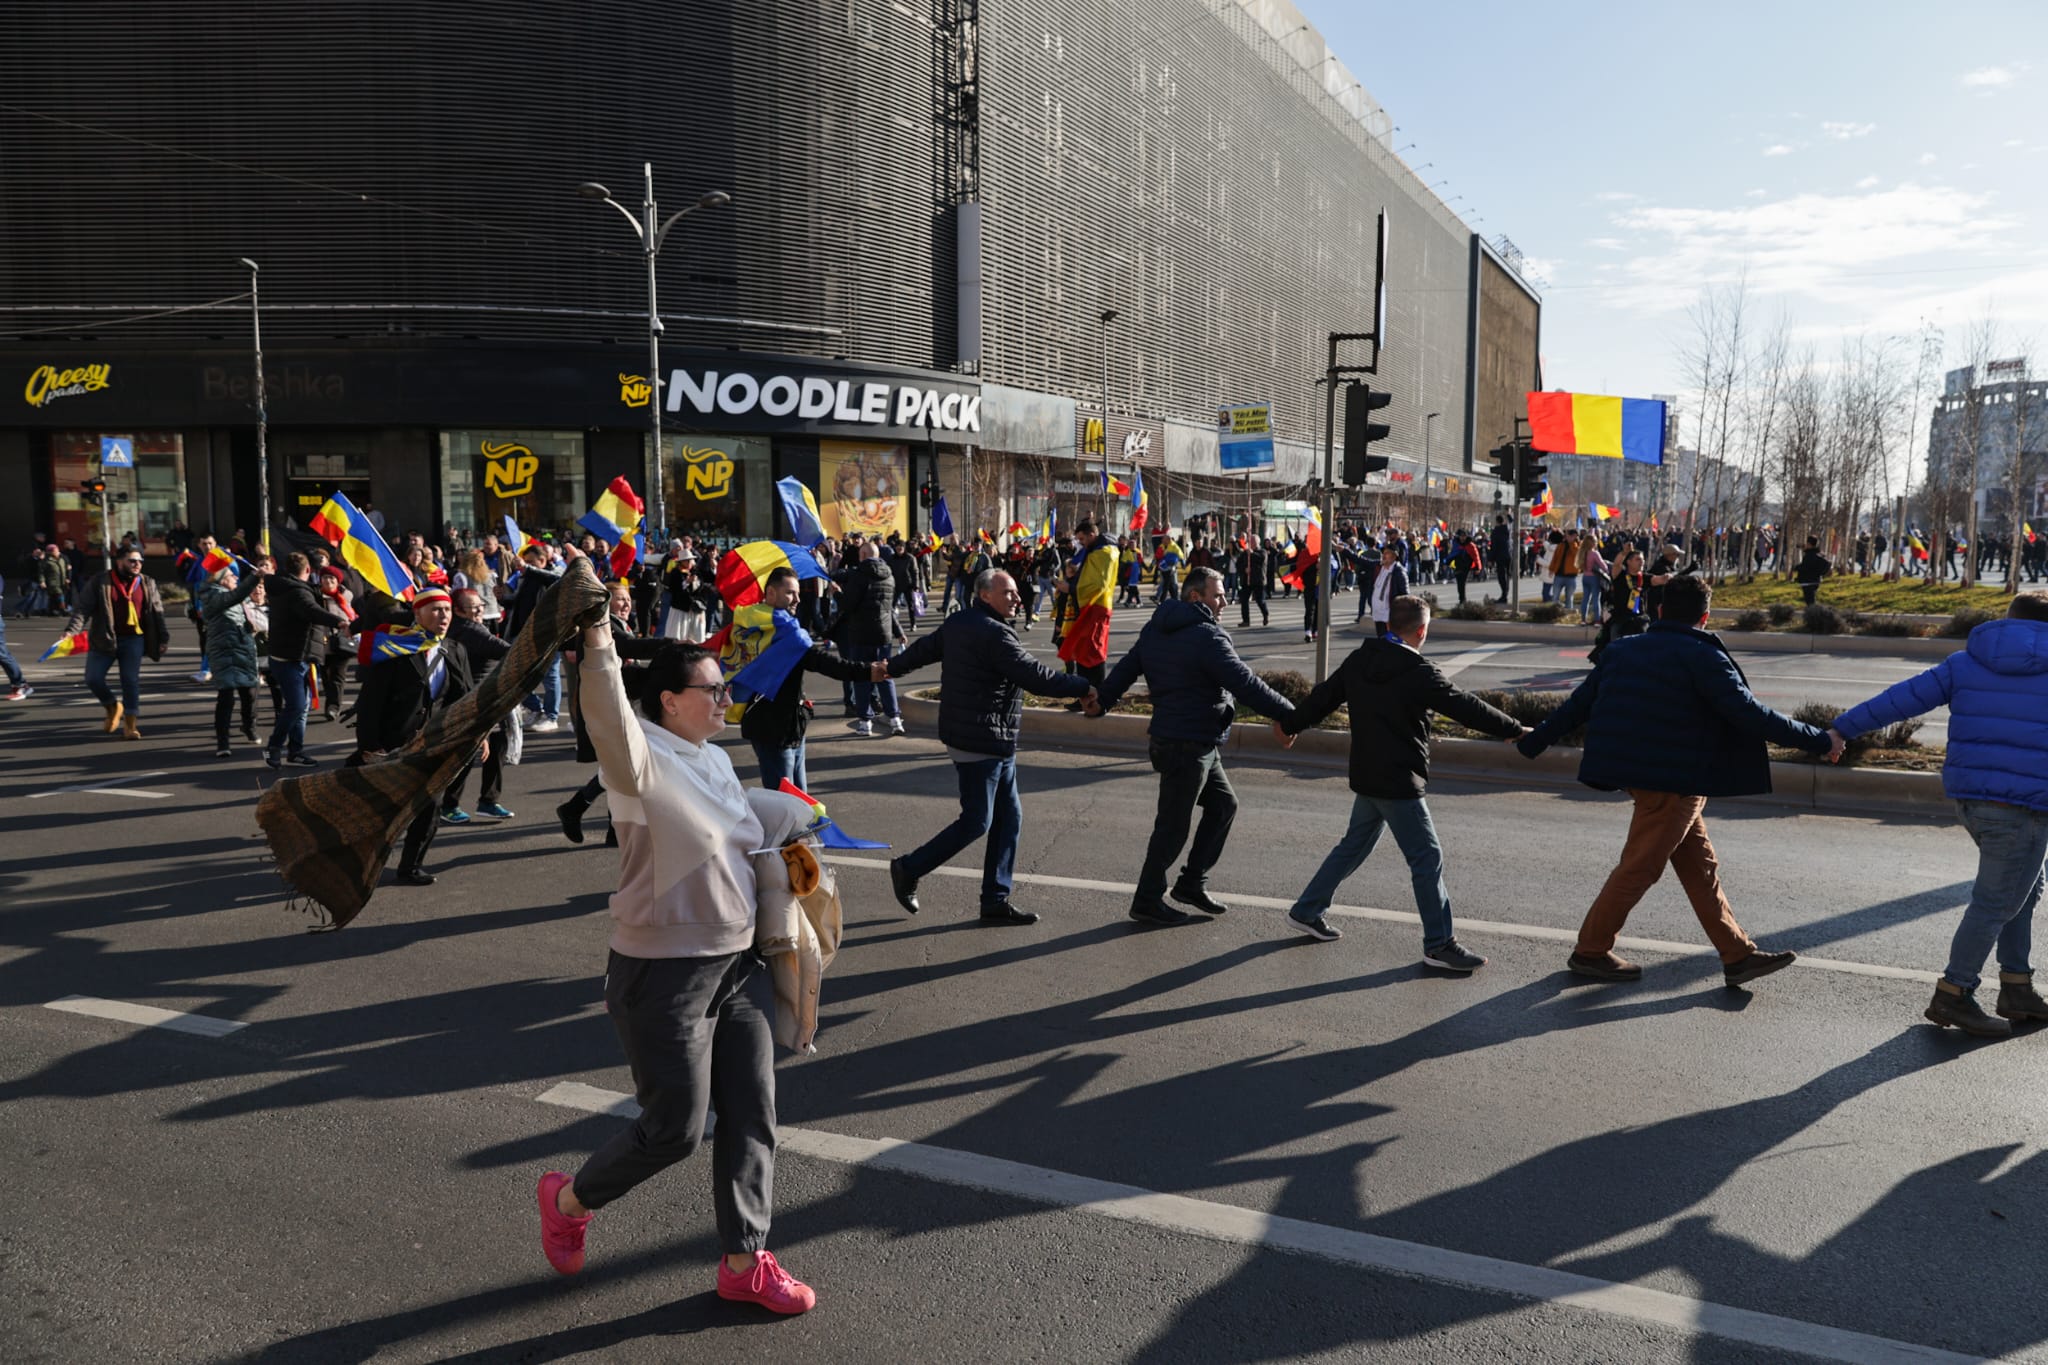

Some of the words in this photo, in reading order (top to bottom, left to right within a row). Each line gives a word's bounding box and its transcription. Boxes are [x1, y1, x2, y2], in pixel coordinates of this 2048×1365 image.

[25, 364, 111, 405] Cheesy
[45, 384, 88, 405] pasta
[203, 368, 345, 400] Beshka
[621, 384, 652, 402] NP
[666, 369, 890, 424] NOODLE
[896, 386, 982, 432] PACK
[484, 456, 539, 488] NP
[685, 460, 735, 490] NP
